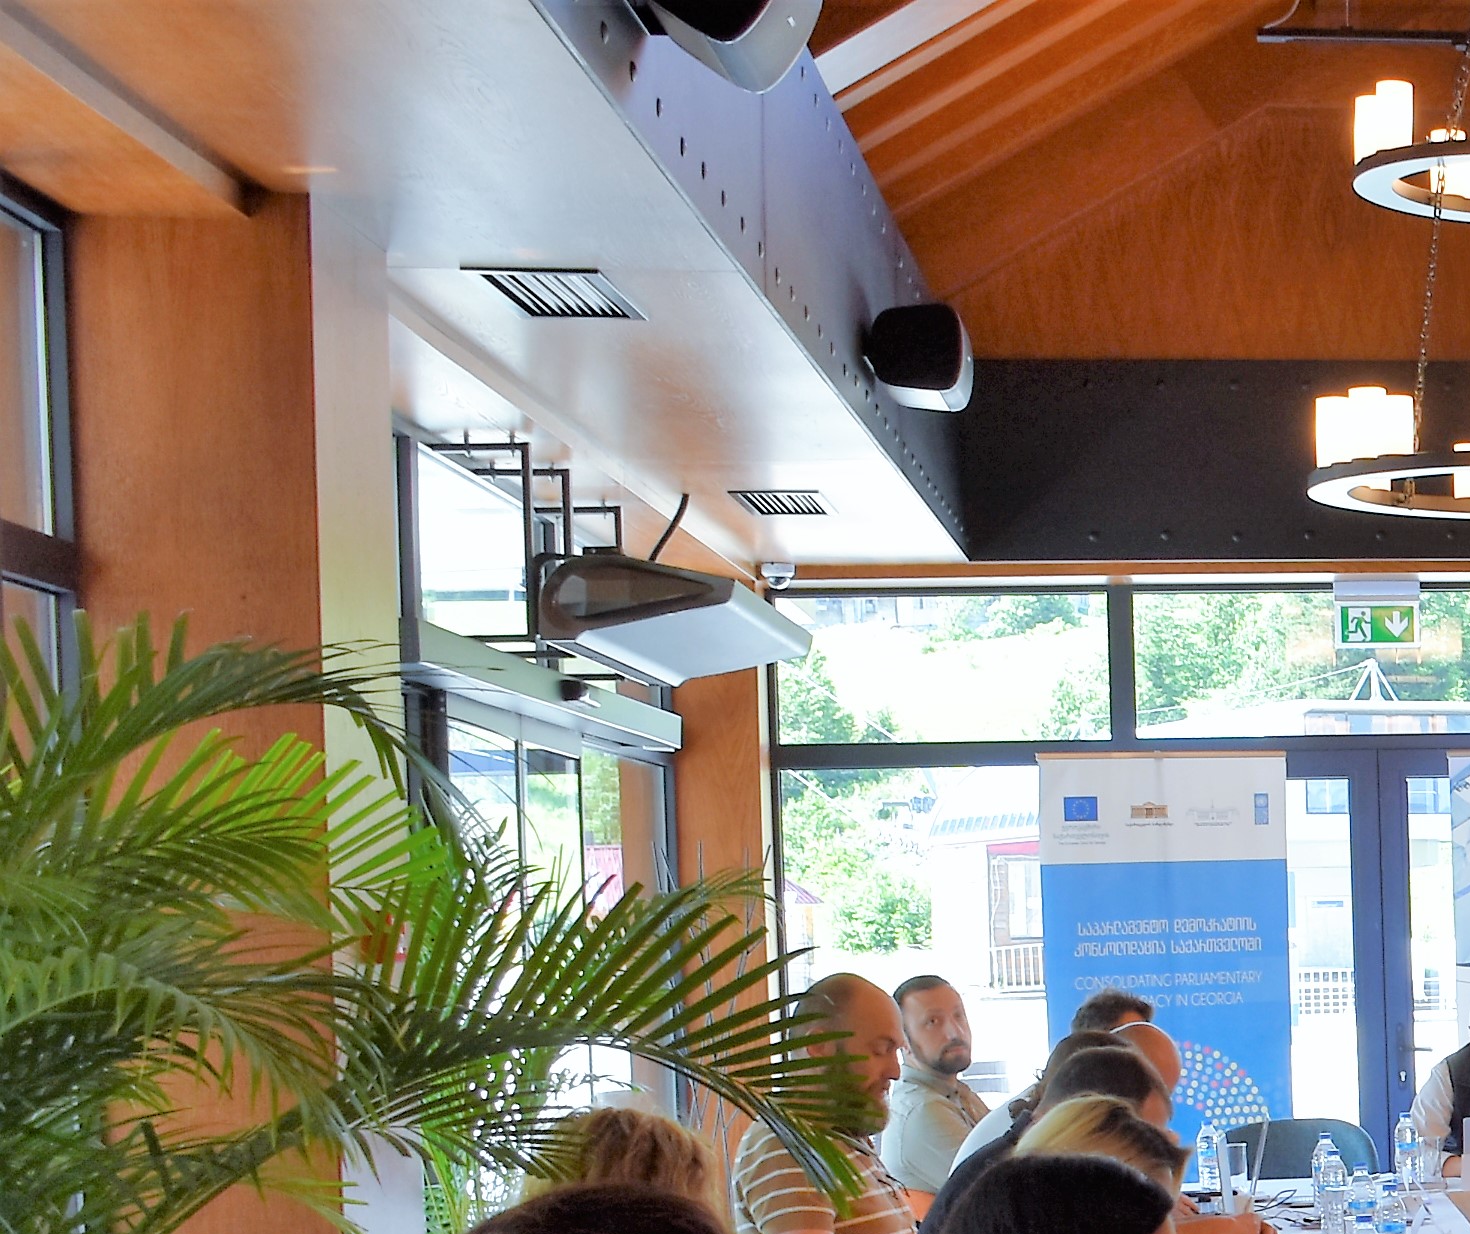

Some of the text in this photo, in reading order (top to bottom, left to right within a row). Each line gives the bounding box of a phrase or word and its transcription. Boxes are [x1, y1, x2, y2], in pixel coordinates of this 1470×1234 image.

[1074, 970, 1263, 991] CONSOLIDATING PARLIAMENTARY
[1175, 993, 1189, 1007] IN
[1191, 990, 1244, 1007] GEORGIA
